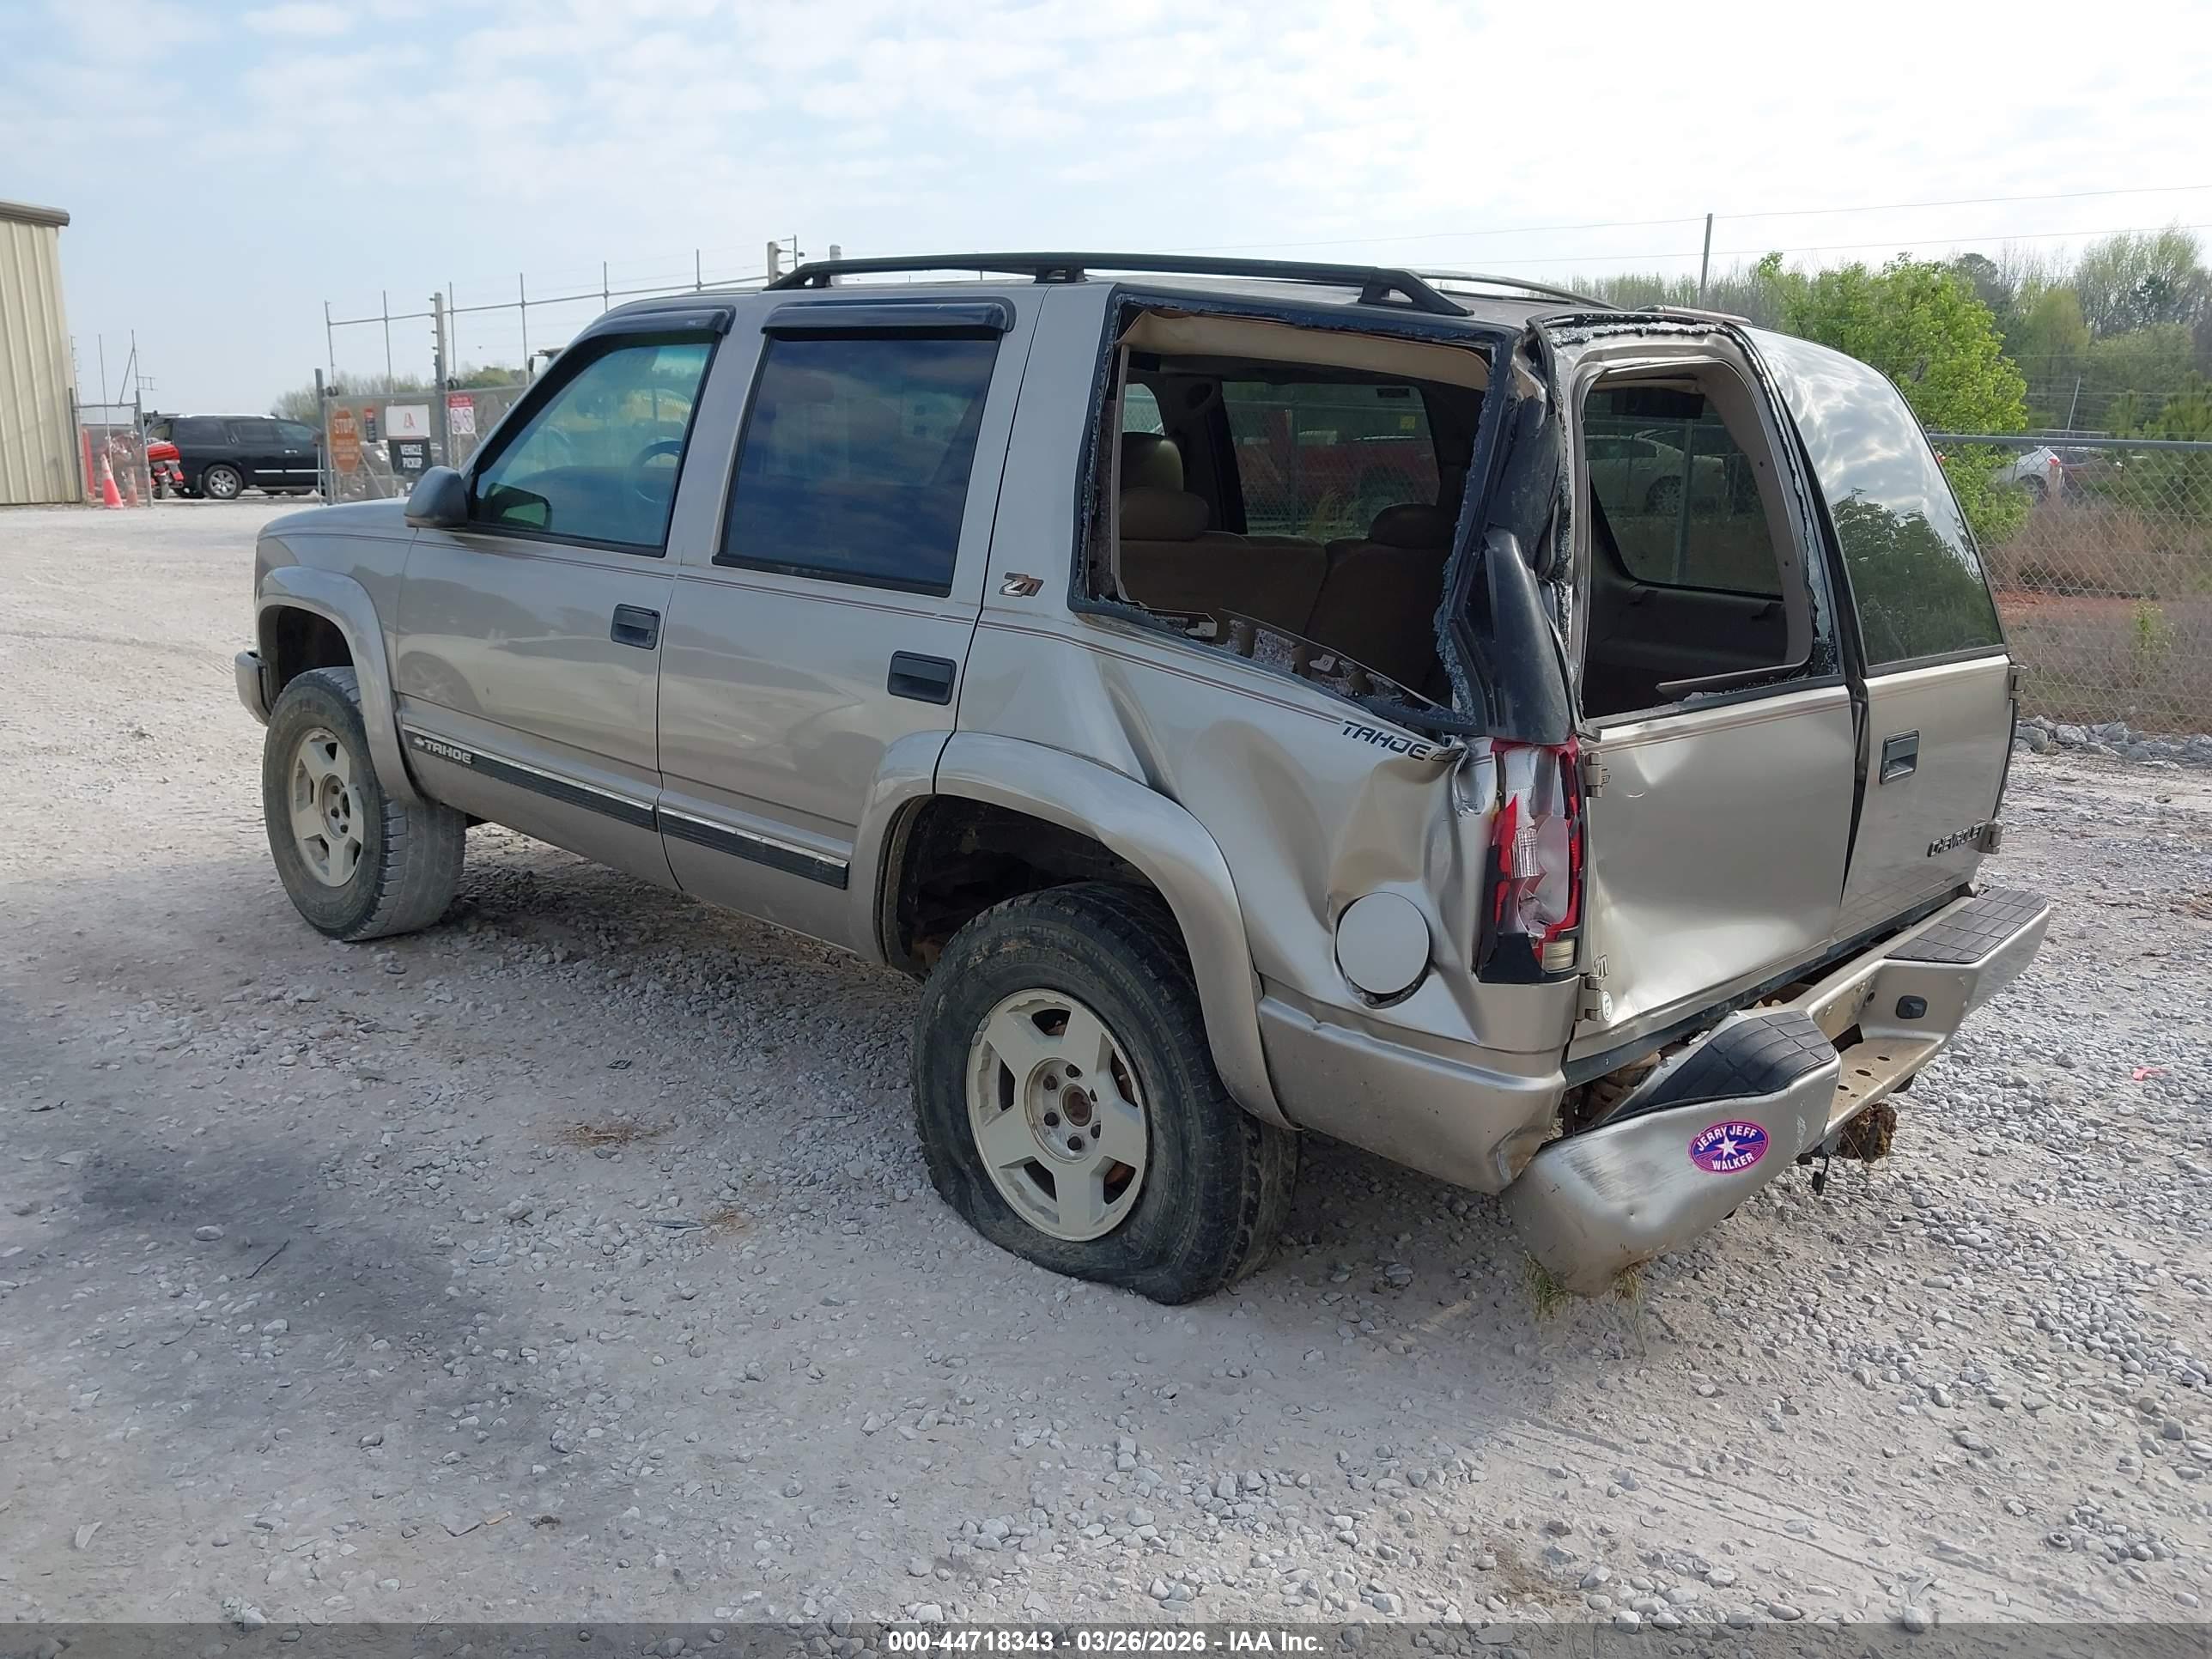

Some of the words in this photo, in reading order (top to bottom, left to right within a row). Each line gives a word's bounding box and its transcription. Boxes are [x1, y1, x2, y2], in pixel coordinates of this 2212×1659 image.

[424, 738, 472, 765] TAHOE
[1342, 720, 1432, 762] TAHOE
[1697, 1126, 1728, 1152] JERRY
[1729, 1125, 1758, 1139] JEFF
[1711, 1152, 1754, 1171] WALKER
